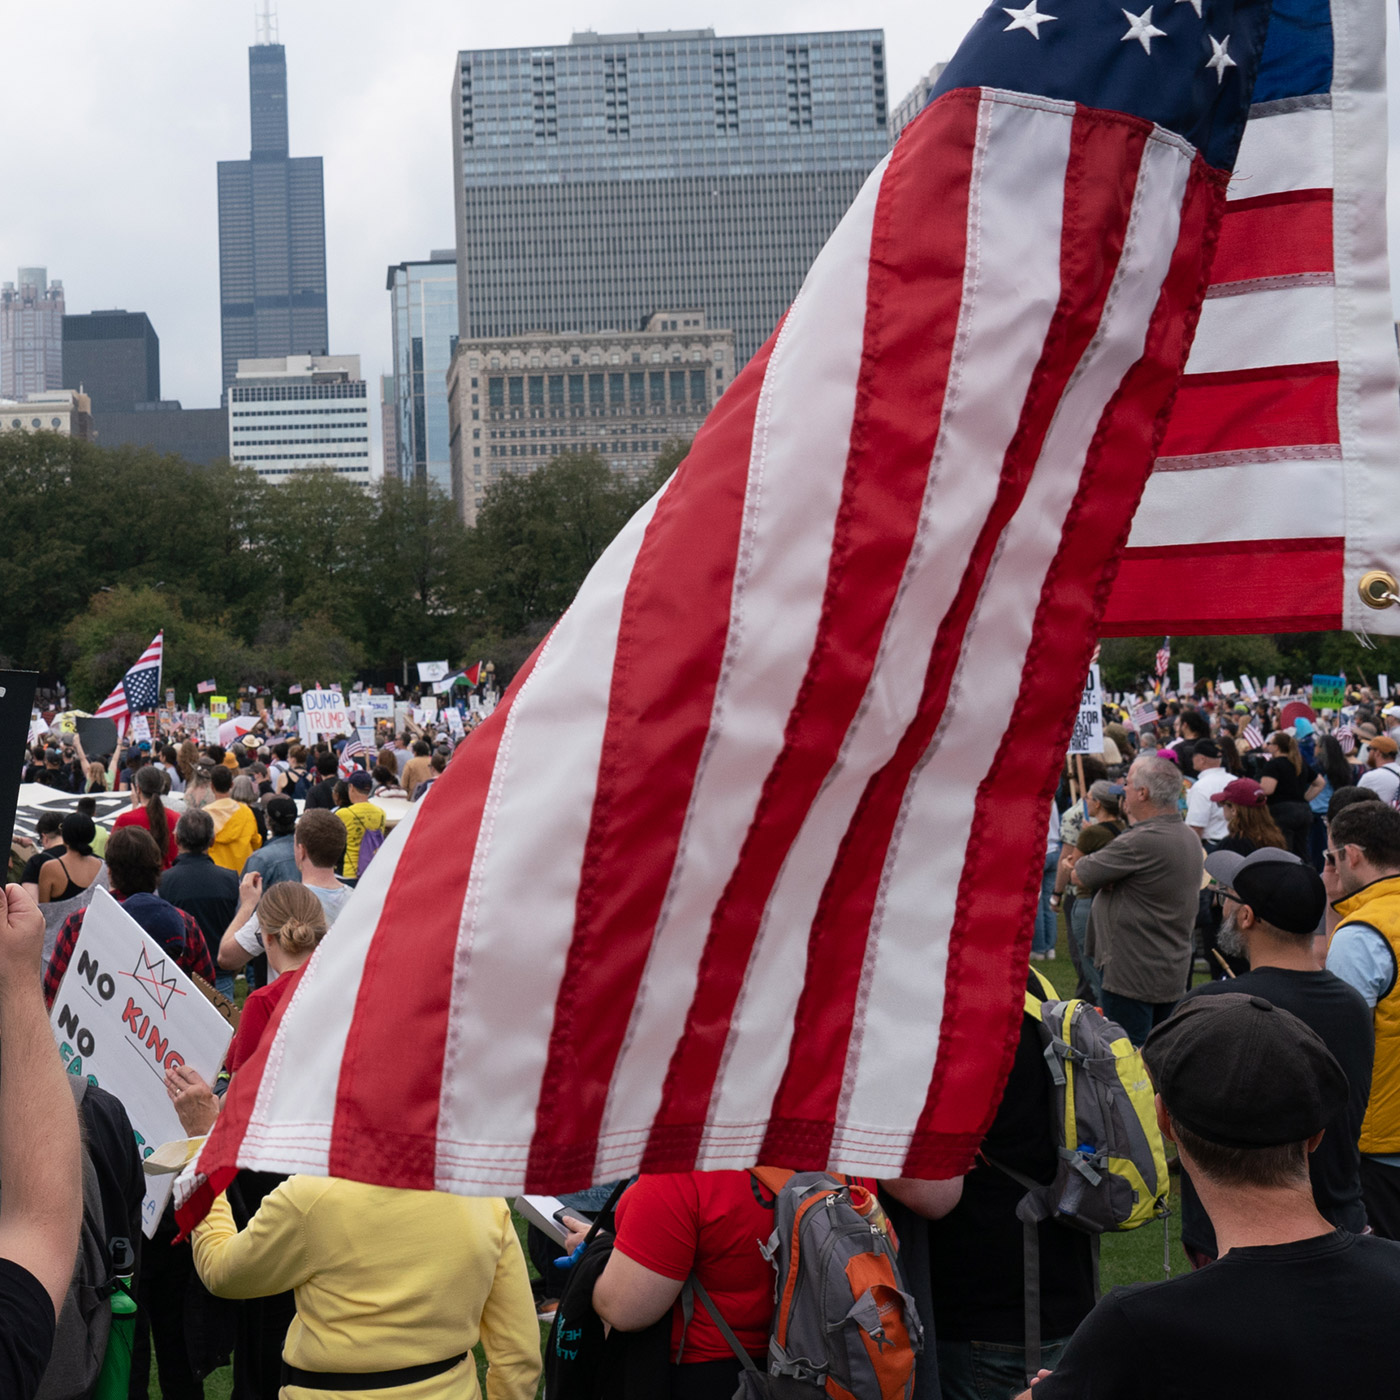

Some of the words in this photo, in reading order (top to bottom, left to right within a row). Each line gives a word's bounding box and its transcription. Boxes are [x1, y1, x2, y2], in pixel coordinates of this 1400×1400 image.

[305, 693, 341, 710] DUMP
[307, 711, 345, 730] TRUMP
[77, 949, 116, 1001] NO
[121, 997, 186, 1071] KING
[58, 1003, 96, 1058] NO
